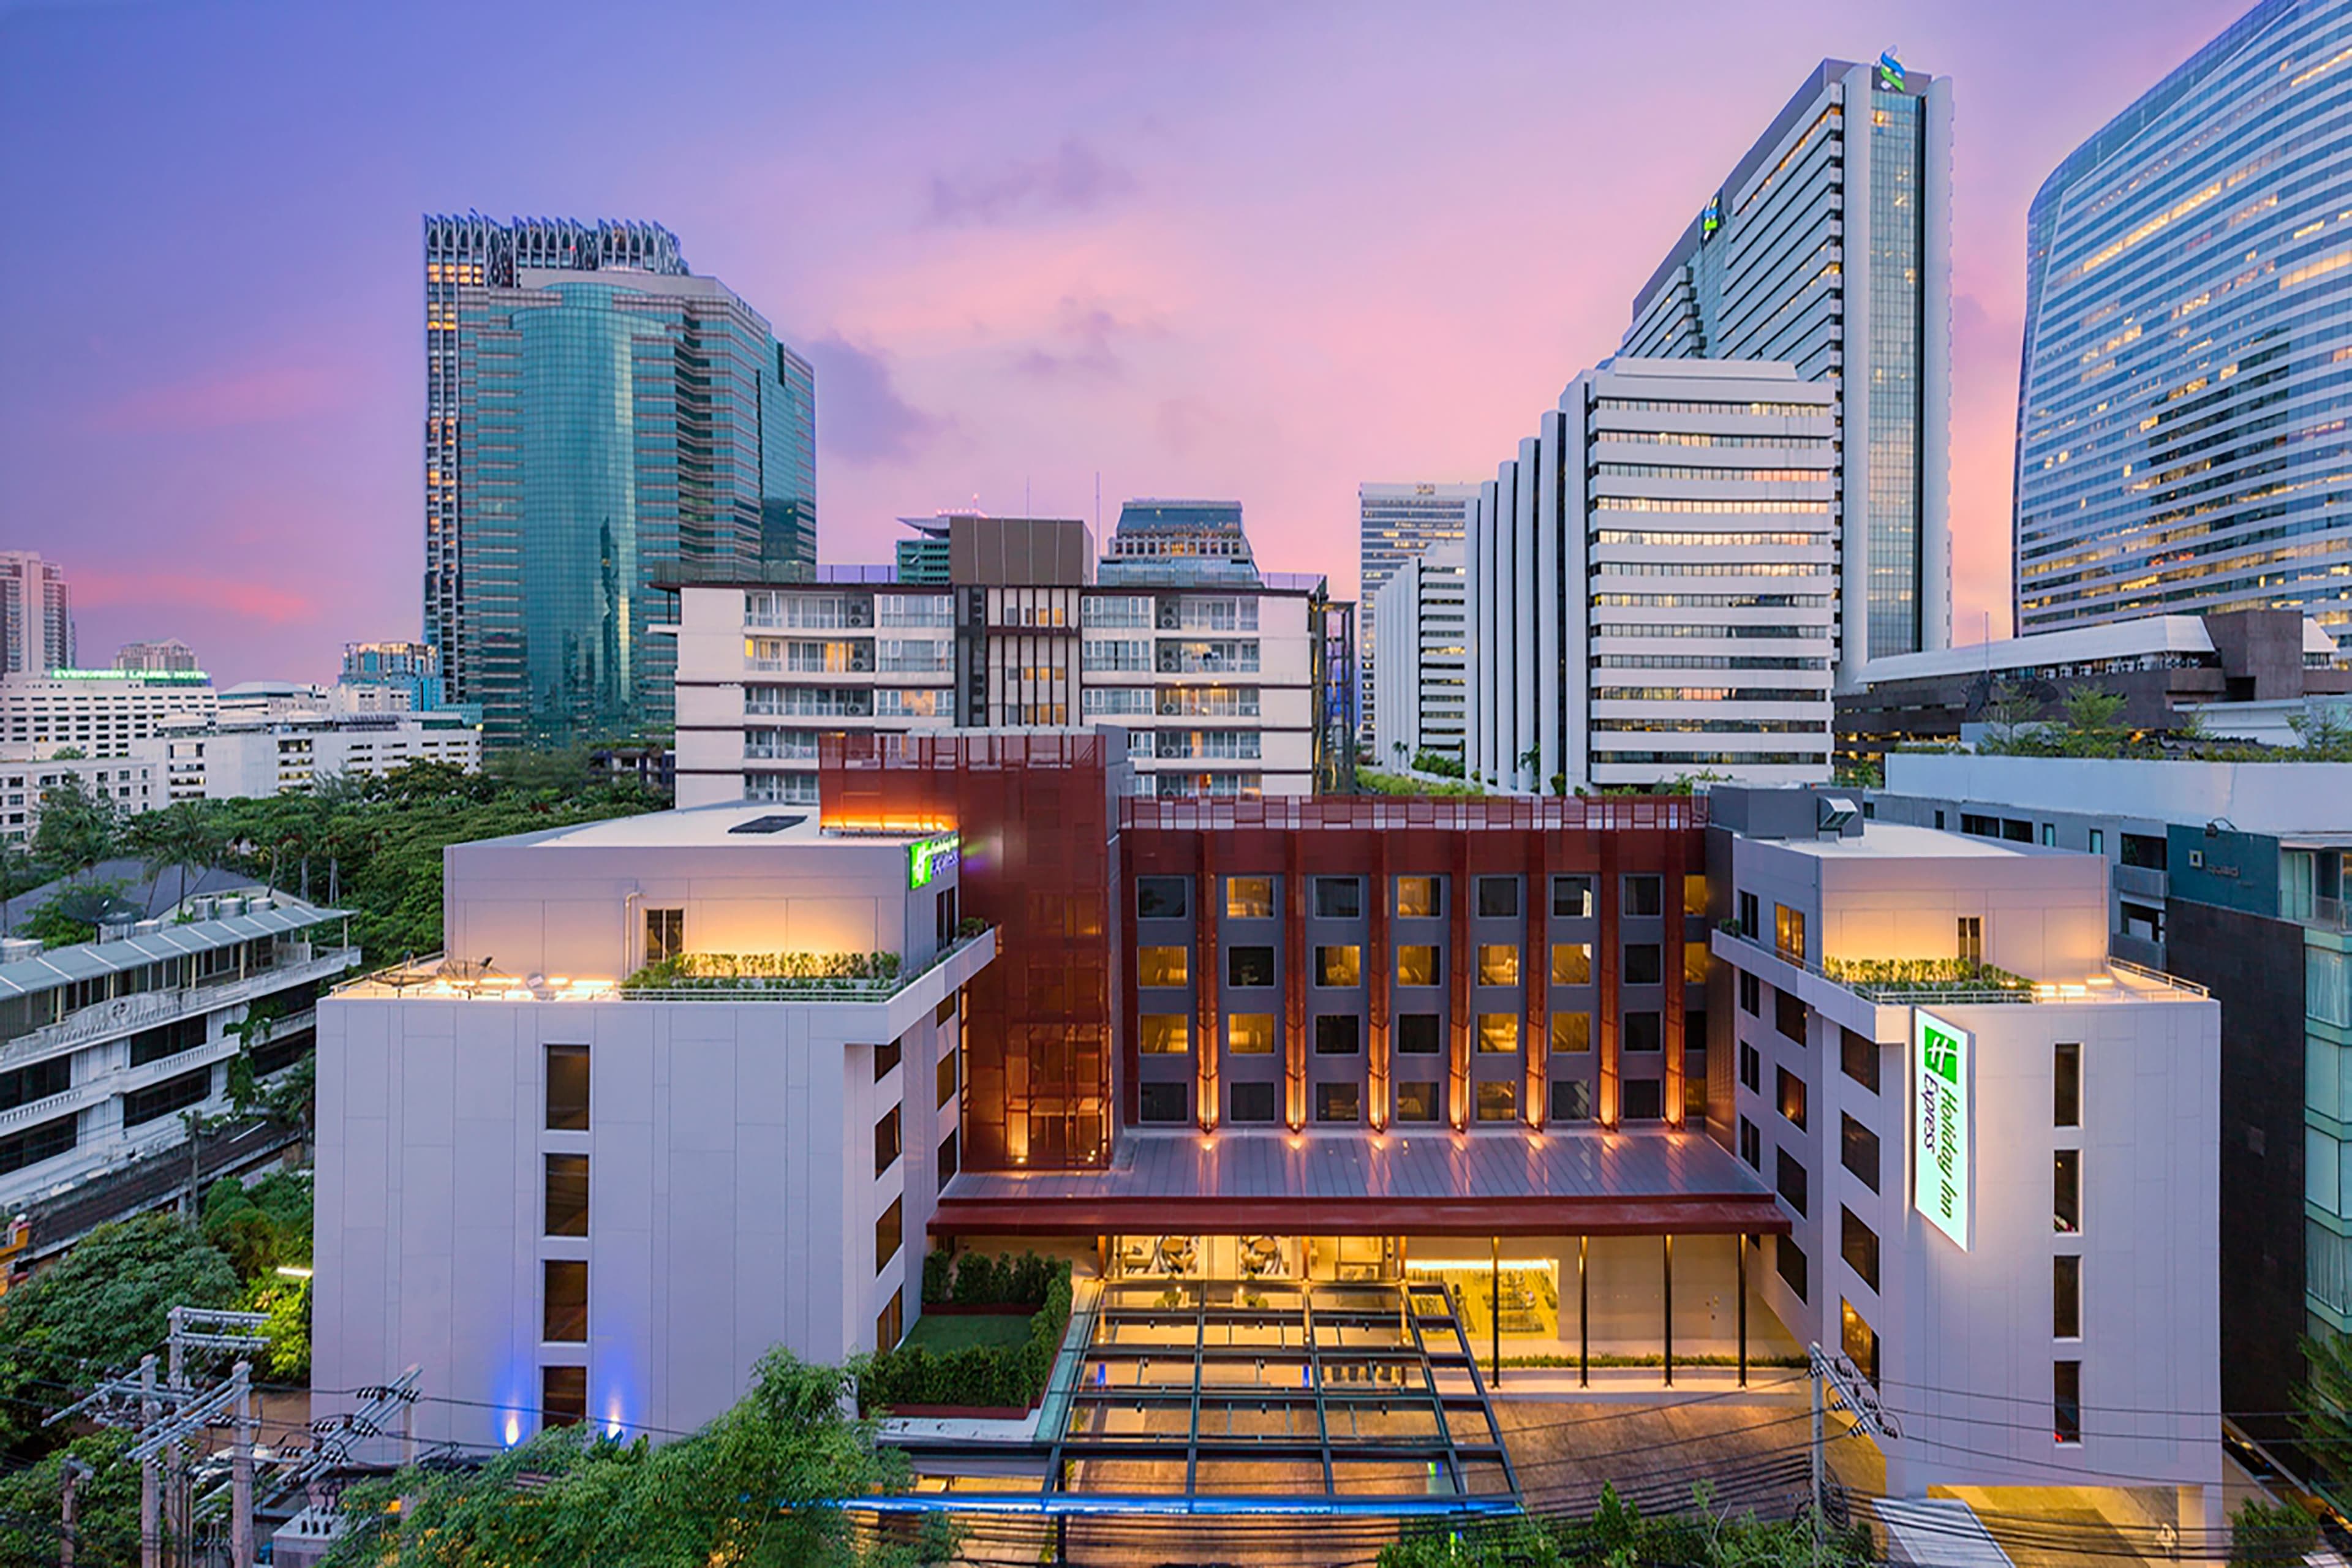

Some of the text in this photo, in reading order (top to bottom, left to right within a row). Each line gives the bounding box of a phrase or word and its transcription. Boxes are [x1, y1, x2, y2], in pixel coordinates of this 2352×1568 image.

[1920, 1073, 1939, 1154] Express
[1937, 1086, 1958, 1219] Holiday Inn
